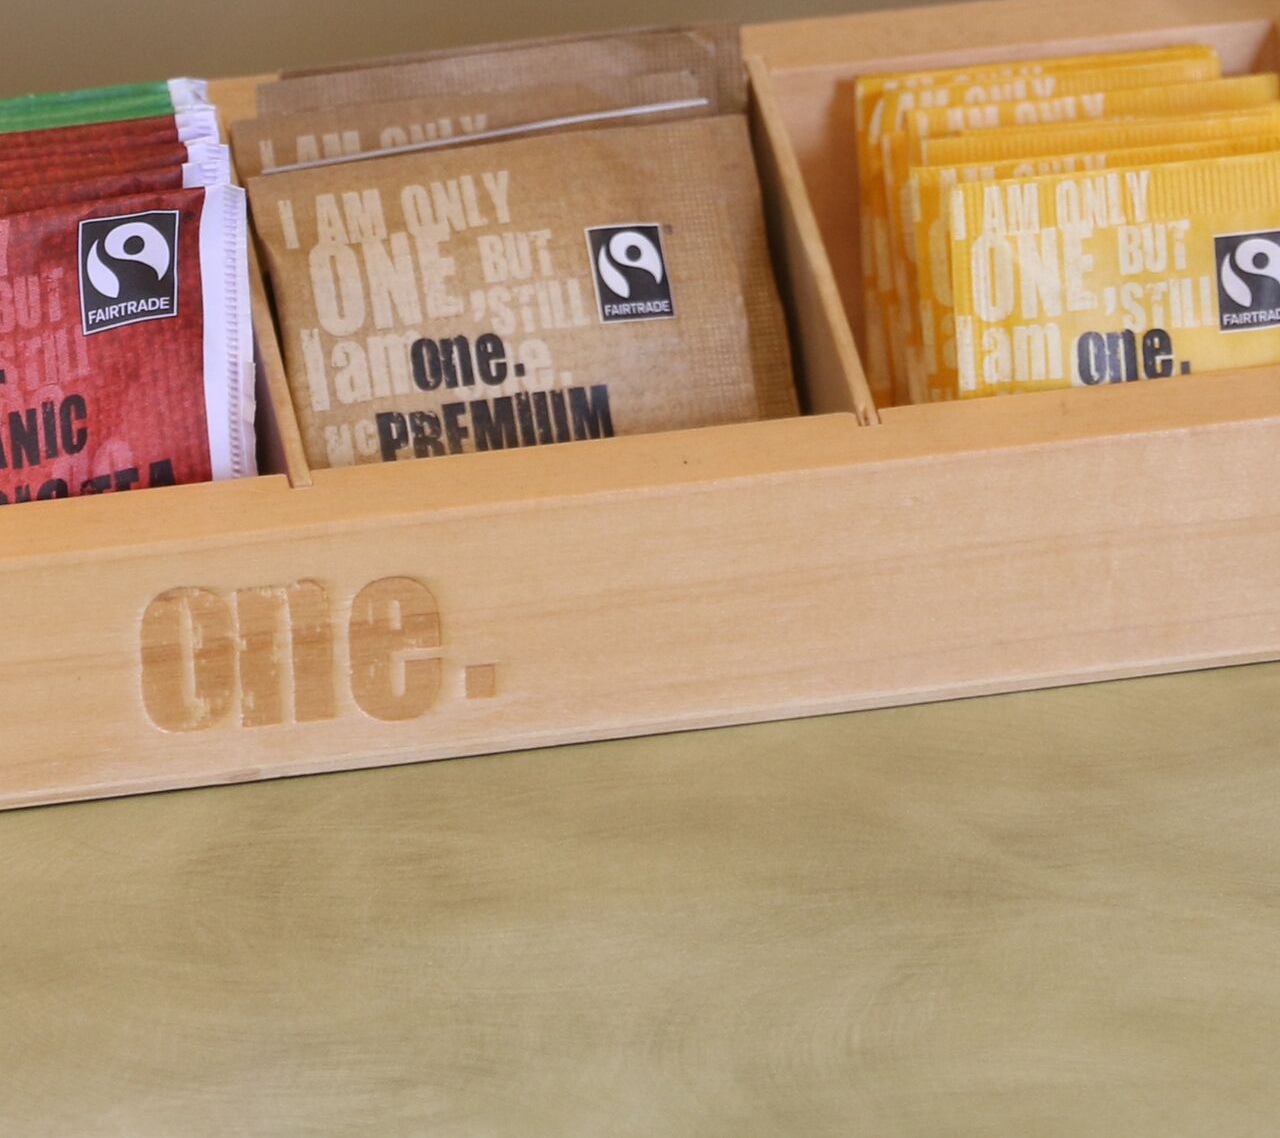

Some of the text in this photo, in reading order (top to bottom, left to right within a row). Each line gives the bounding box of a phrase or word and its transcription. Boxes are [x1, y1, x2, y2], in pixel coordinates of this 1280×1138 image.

[278, 170, 511, 250] I AM ONLY
[951, 189, 966, 241] I
[982, 183, 1039, 234] AM
[1056, 170, 1150, 226] ONLY
[481, 230, 553, 283] BUT
[1119, 220, 1190, 274] BUT
[88, 297, 171, 326] FAIRTRADE
[604, 299, 671, 317] FAIRTRADE
[411, 333, 525, 391] one.
[957, 315, 1064, 391] I am
[1077, 328, 1191, 386] one.
[140, 576, 495, 734] one.
